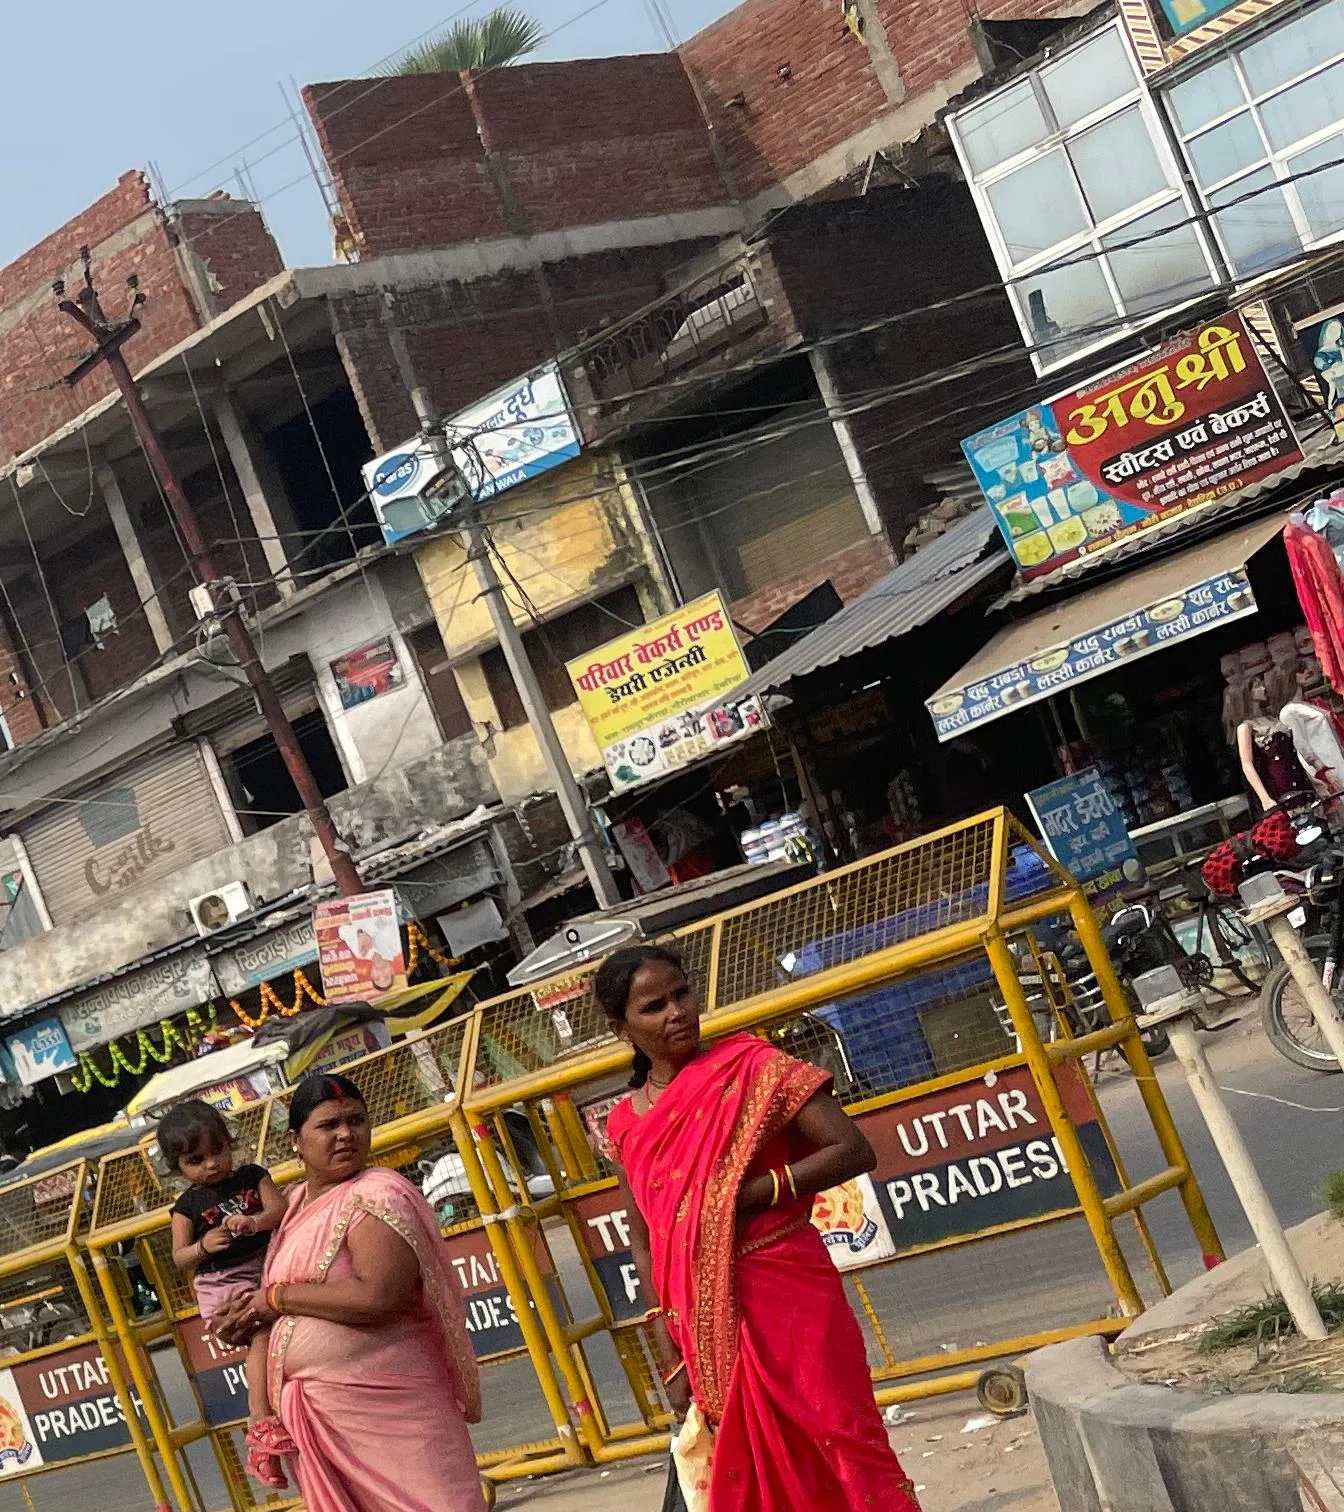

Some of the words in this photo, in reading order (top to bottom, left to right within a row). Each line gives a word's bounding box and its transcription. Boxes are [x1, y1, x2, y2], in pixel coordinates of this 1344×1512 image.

[1065, 325, 1248, 446] अनुश्री
[1103, 437, 1174, 484] स्वीट्स
[1175, 420, 1210, 450] एवं
[1208, 391, 1272, 435] बेकर्स
[497, 469, 528, 492] WALA
[576, 653, 635, 691] परिवार
[683, 609, 724, 641] एण्ड
[648, 645, 707, 682] एजेन्सी
[1037, 663, 1075, 691] लस्सी
[938, 709, 970, 733] लस्सी
[896, 1089, 1037, 1157] UTTAR
